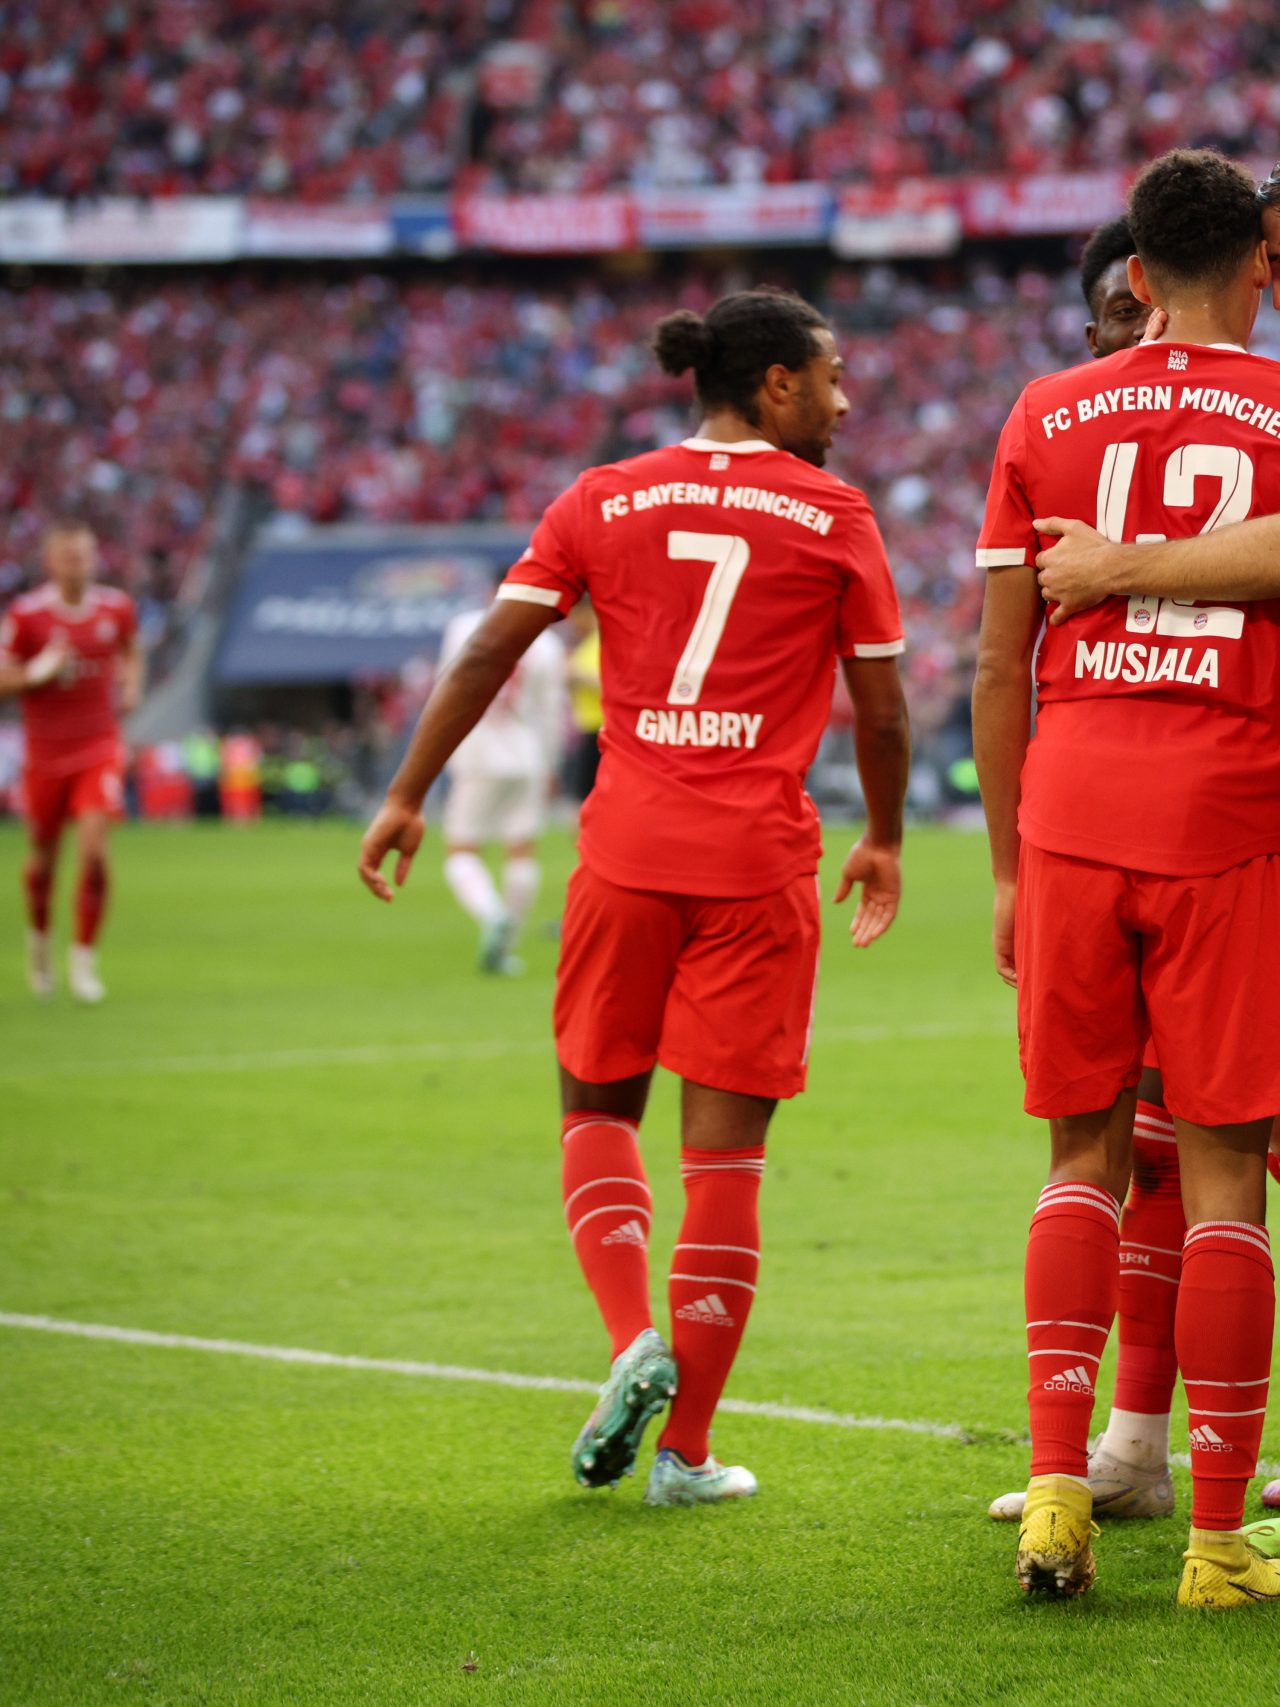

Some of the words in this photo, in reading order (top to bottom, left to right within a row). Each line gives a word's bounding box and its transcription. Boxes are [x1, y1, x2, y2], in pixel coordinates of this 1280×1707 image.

[1168, 357, 1188, 365] SAN
[1168, 363, 1186, 371] MIA
[1170, 350, 1188, 358] MIA
[1041, 408, 1072, 440] FC
[1077, 386, 1172, 423] BAYERN
[601, 494, 629, 522] FC
[633, 482, 718, 511] BAYERN
[722, 486, 834, 536] MÜNCHEN
[667, 530, 751, 705] 7
[1075, 640, 1219, 688] MUSIALA
[635, 709, 763, 749] GNABRY
[675, 1308, 734, 1328] adidas
